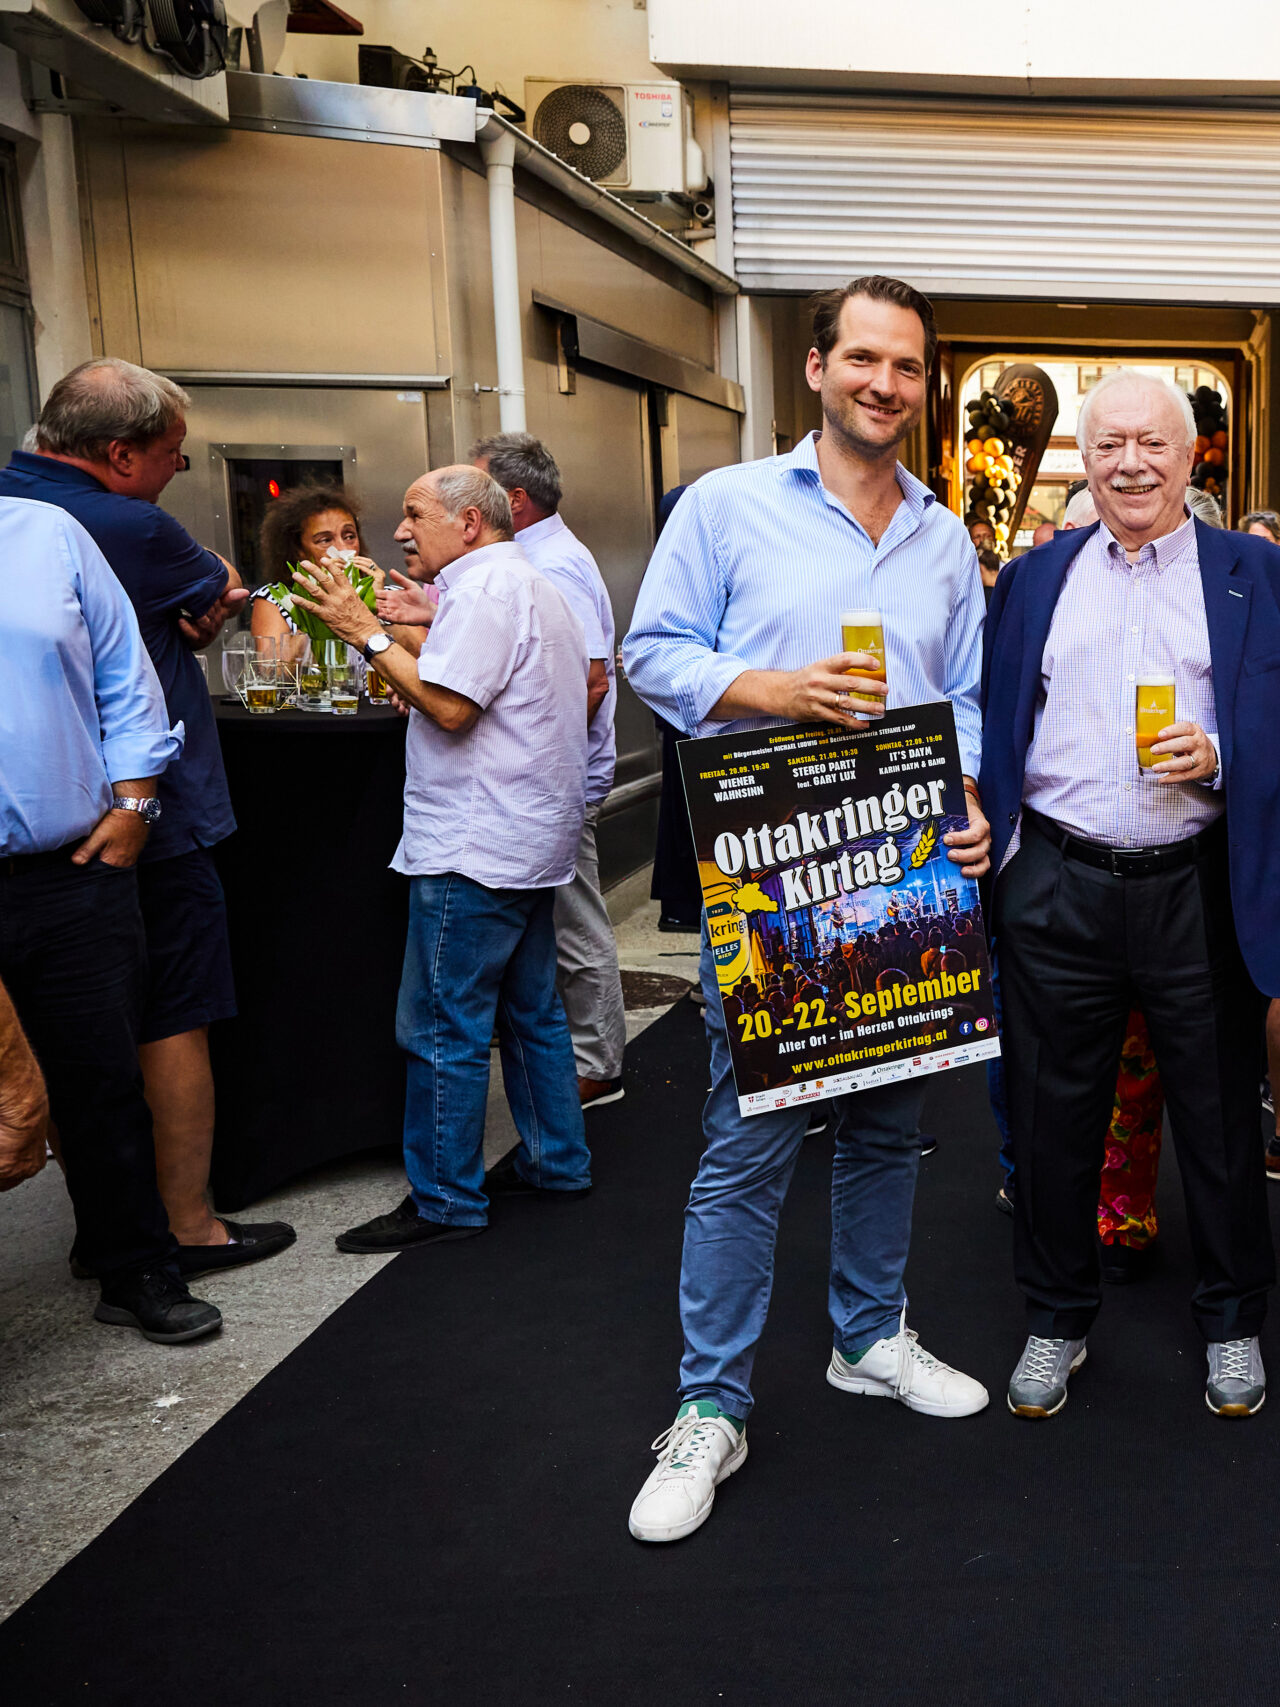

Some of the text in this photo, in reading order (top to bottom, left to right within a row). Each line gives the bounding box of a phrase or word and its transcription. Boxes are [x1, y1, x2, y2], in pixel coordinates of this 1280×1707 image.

[635, 92, 672, 100] TOSHIBA
[734, 748, 772, 759] Bürgermeister
[774, 742, 796, 752] MICHAEL
[798, 740, 818, 748] LUDWIG
[879, 726, 902, 736] STEFANIE
[902, 724, 916, 732] LAMP
[875, 734, 943, 752] SONNTAG, 22.09. 19:00
[787, 748, 858, 766] SAMSTAG, 21.09. 19:30
[908, 746, 932, 758] DAYM
[700, 762, 770, 780] FREITAG, 20.09. 19:30
[792, 758, 856, 778] STEREO PARTY
[879, 766, 900, 775] KARIN
[901, 762, 920, 772] DAYM
[928, 757, 946, 766] BAND
[718, 775, 756, 790] WIENER
[796, 770, 856, 788] feat. GARY LUX
[714, 786, 764, 802] WAHNSINN
[714, 778, 946, 876] Ottakringer
[780, 836, 902, 911] Kirtag
[737, 968, 982, 1042] 20.-22. September
[778, 1038, 806, 1054] Alter
[810, 1034, 827, 1046] Ort
[839, 1028, 854, 1040] im
[857, 1022, 895, 1038] Herzen
[898, 1006, 954, 1028] Ottakrings
[792, 1028, 948, 1074] www.ottakringerkirtag.at
